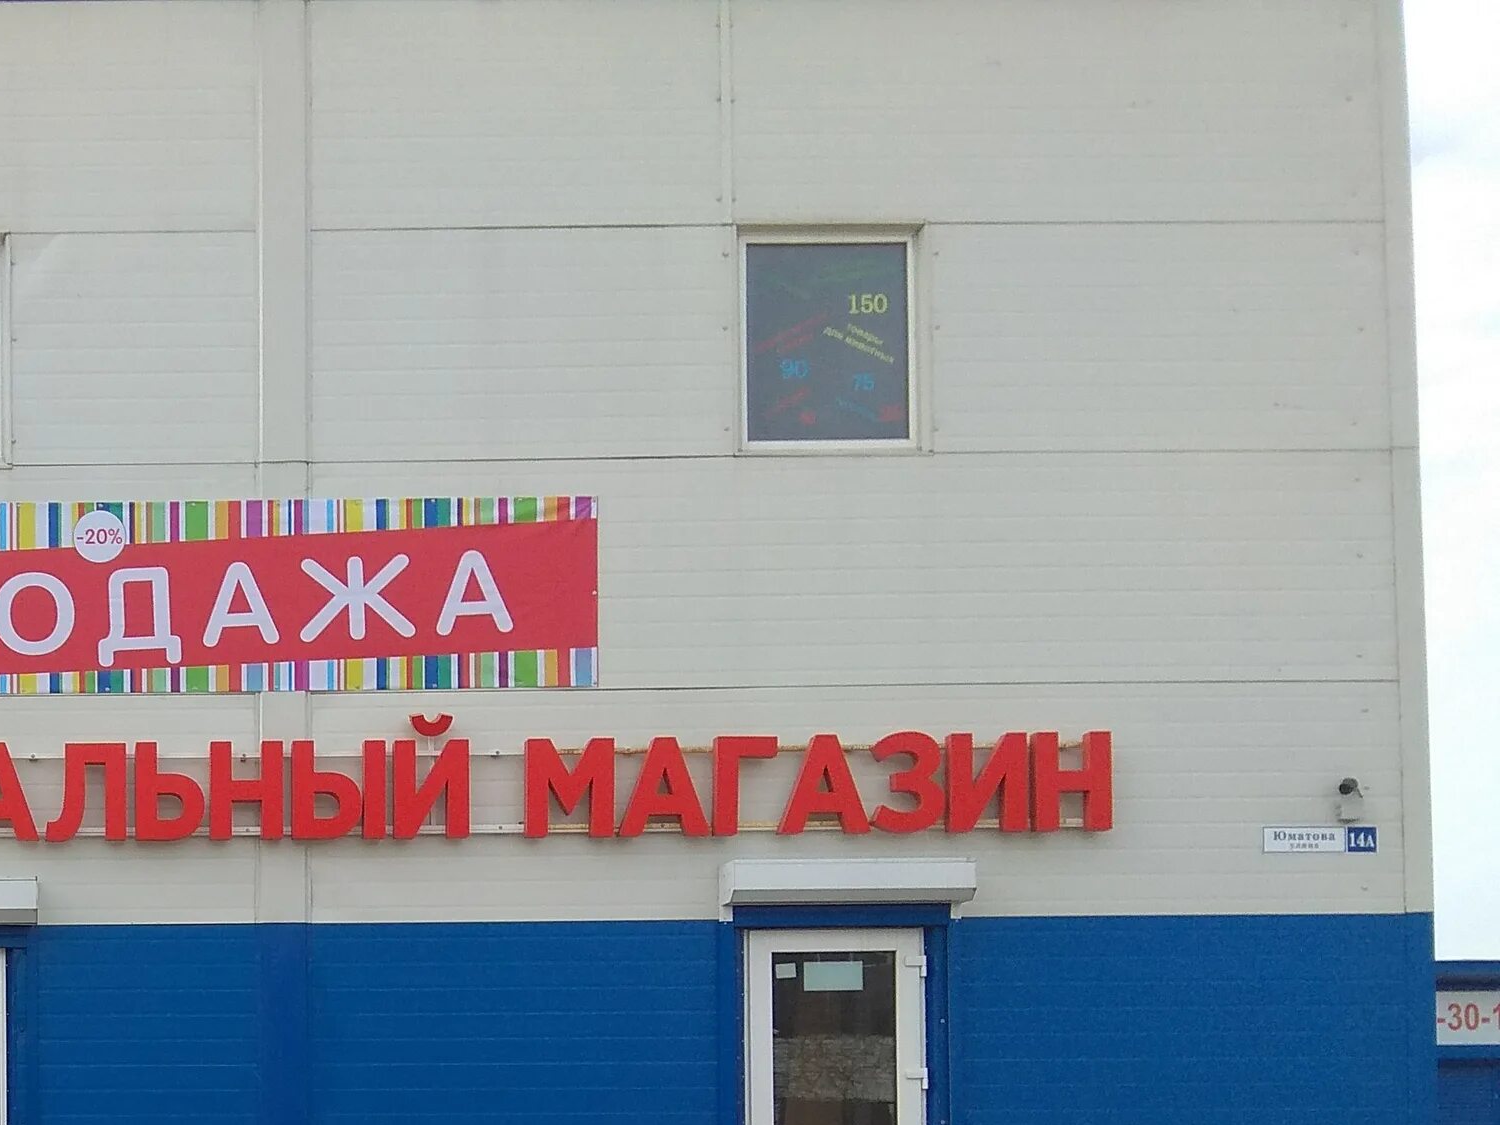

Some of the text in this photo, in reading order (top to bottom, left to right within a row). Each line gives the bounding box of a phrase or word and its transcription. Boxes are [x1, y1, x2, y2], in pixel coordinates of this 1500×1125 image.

[848, 293, 888, 315] 150
[75, 526, 124, 547] -20%
[523, 730, 1114, 838] МАГАЗИН
[1273, 830, 1336, 841] Юматова
